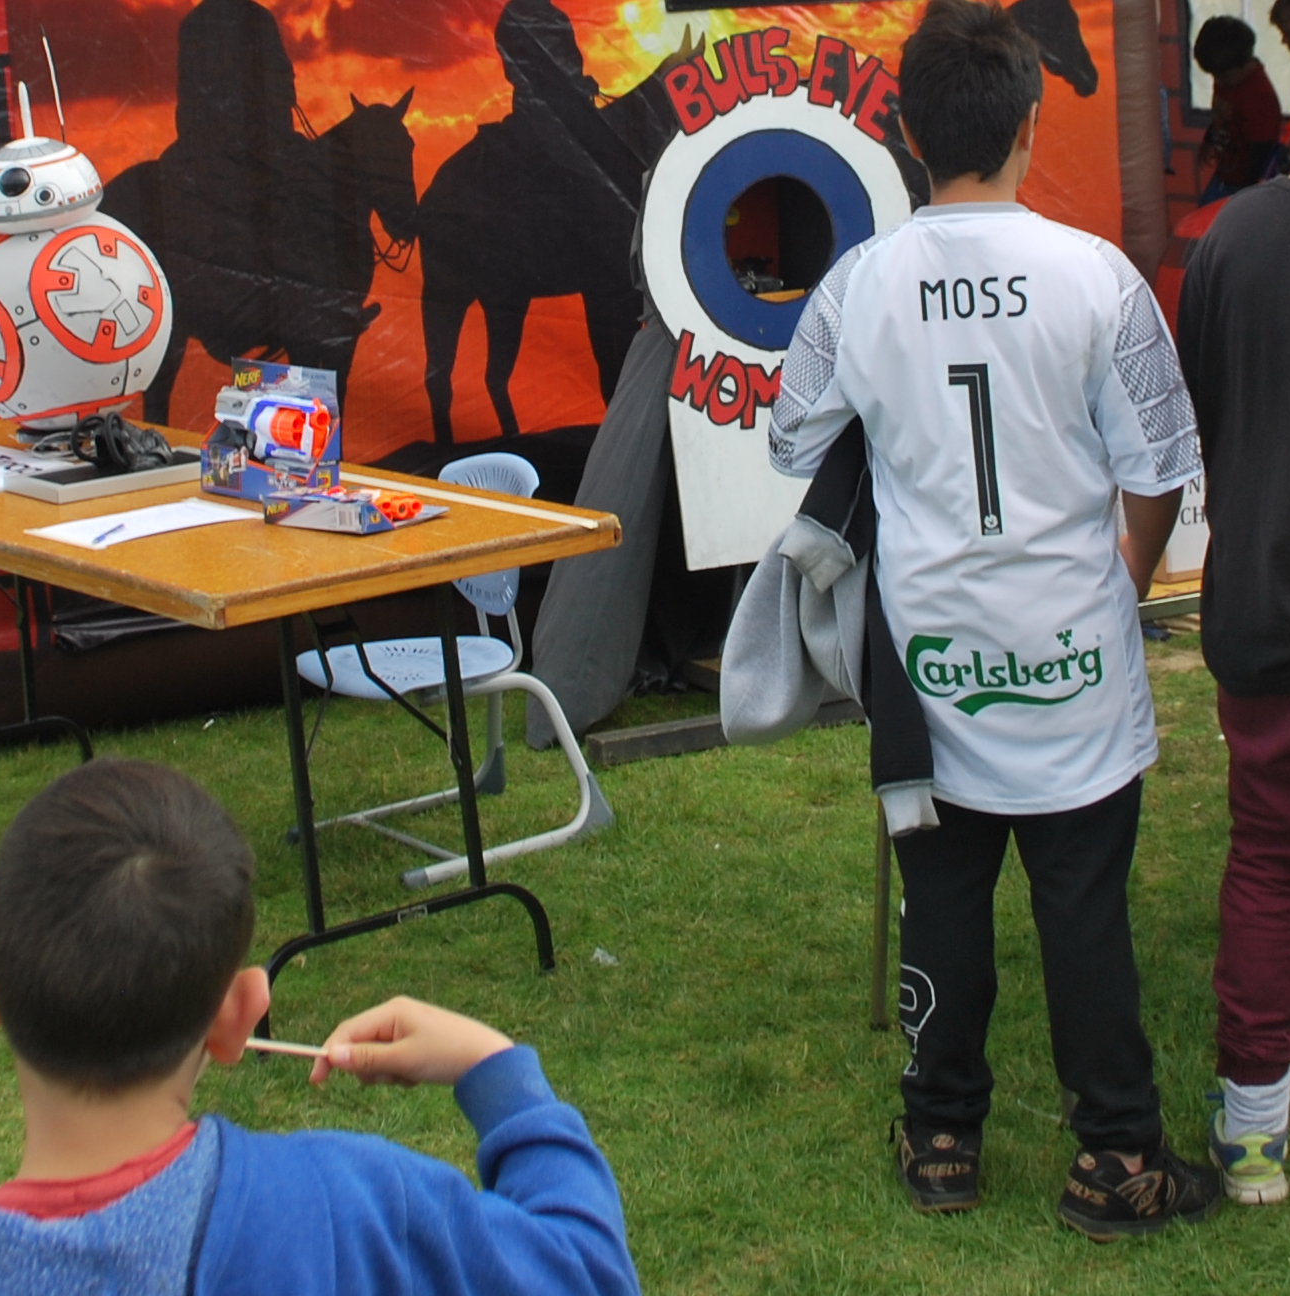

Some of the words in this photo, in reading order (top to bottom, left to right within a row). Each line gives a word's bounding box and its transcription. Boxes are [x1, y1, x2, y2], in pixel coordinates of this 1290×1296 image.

[663, 26, 800, 137] BULLS
[807, 34, 900, 142] EYE
[919, 275, 1027, 322] MOSS
[234, 369, 262, 389] NERF
[947, 363, 1003, 536] 1
[906, 634, 1103, 717] Carlsberg
